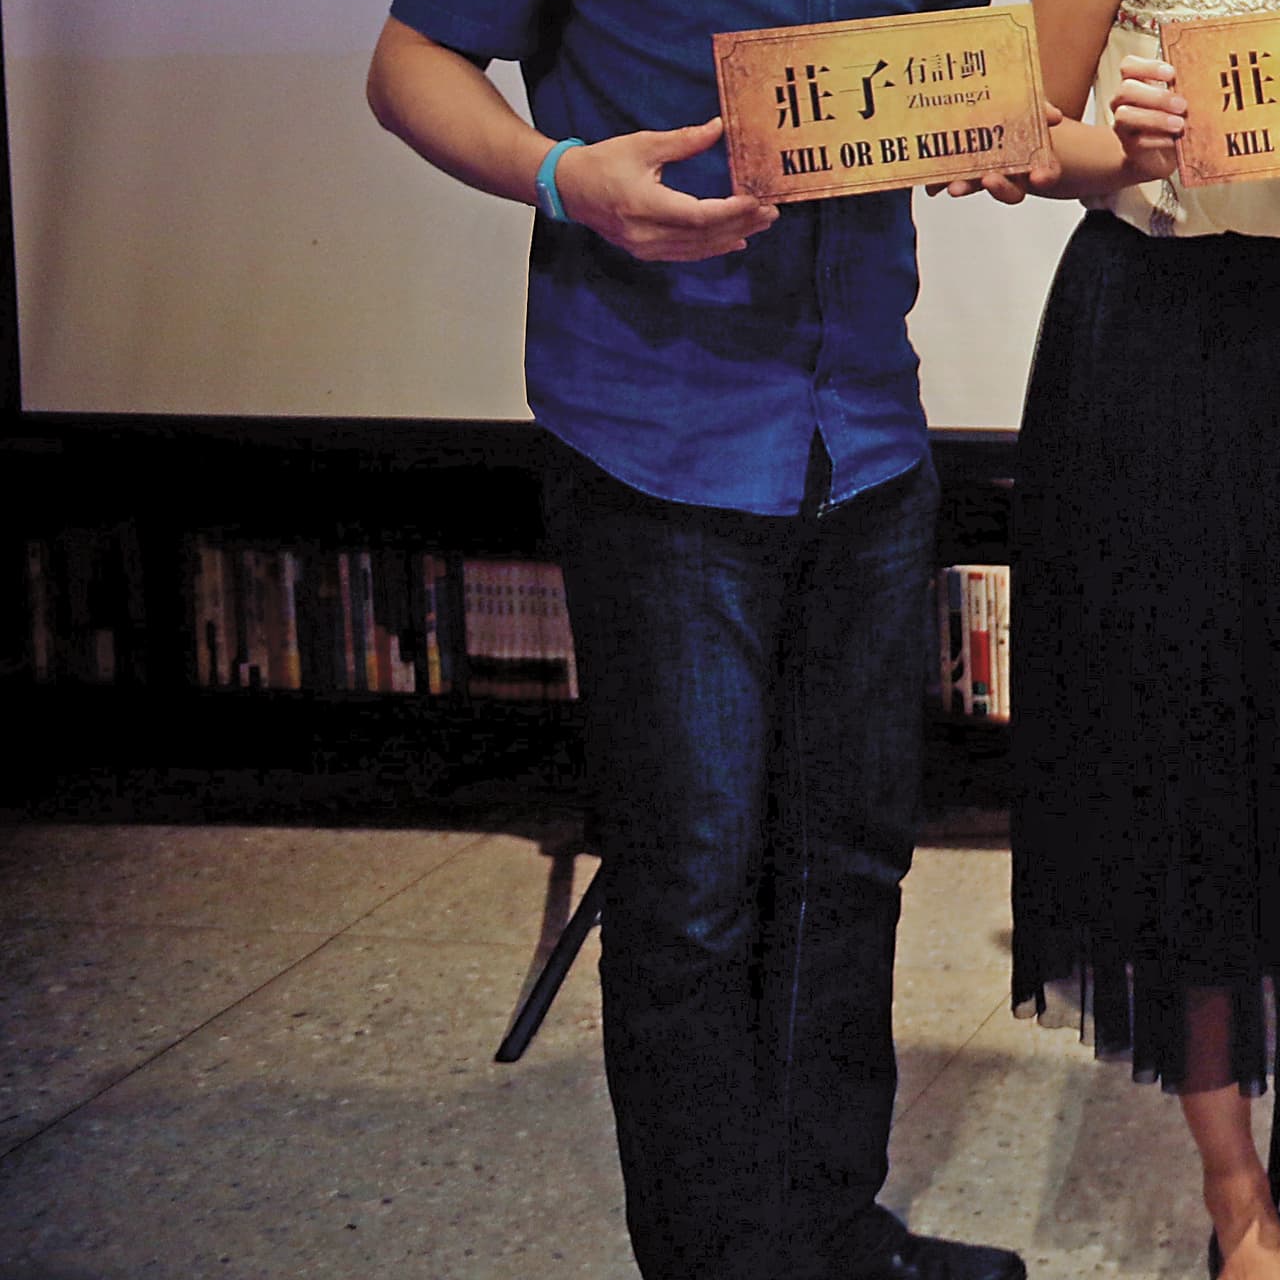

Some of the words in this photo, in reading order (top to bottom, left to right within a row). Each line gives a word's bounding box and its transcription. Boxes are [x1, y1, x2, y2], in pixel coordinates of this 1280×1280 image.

[776, 59, 896, 128] 莊子
[907, 86, 990, 109] Zhuangzi
[780, 146, 832, 175] KILL
[840, 141, 873, 168] OR
[879, 136, 909, 164] BE
[916, 125, 1004, 159] KILLED?
[1225, 129, 1275, 156] KILL
